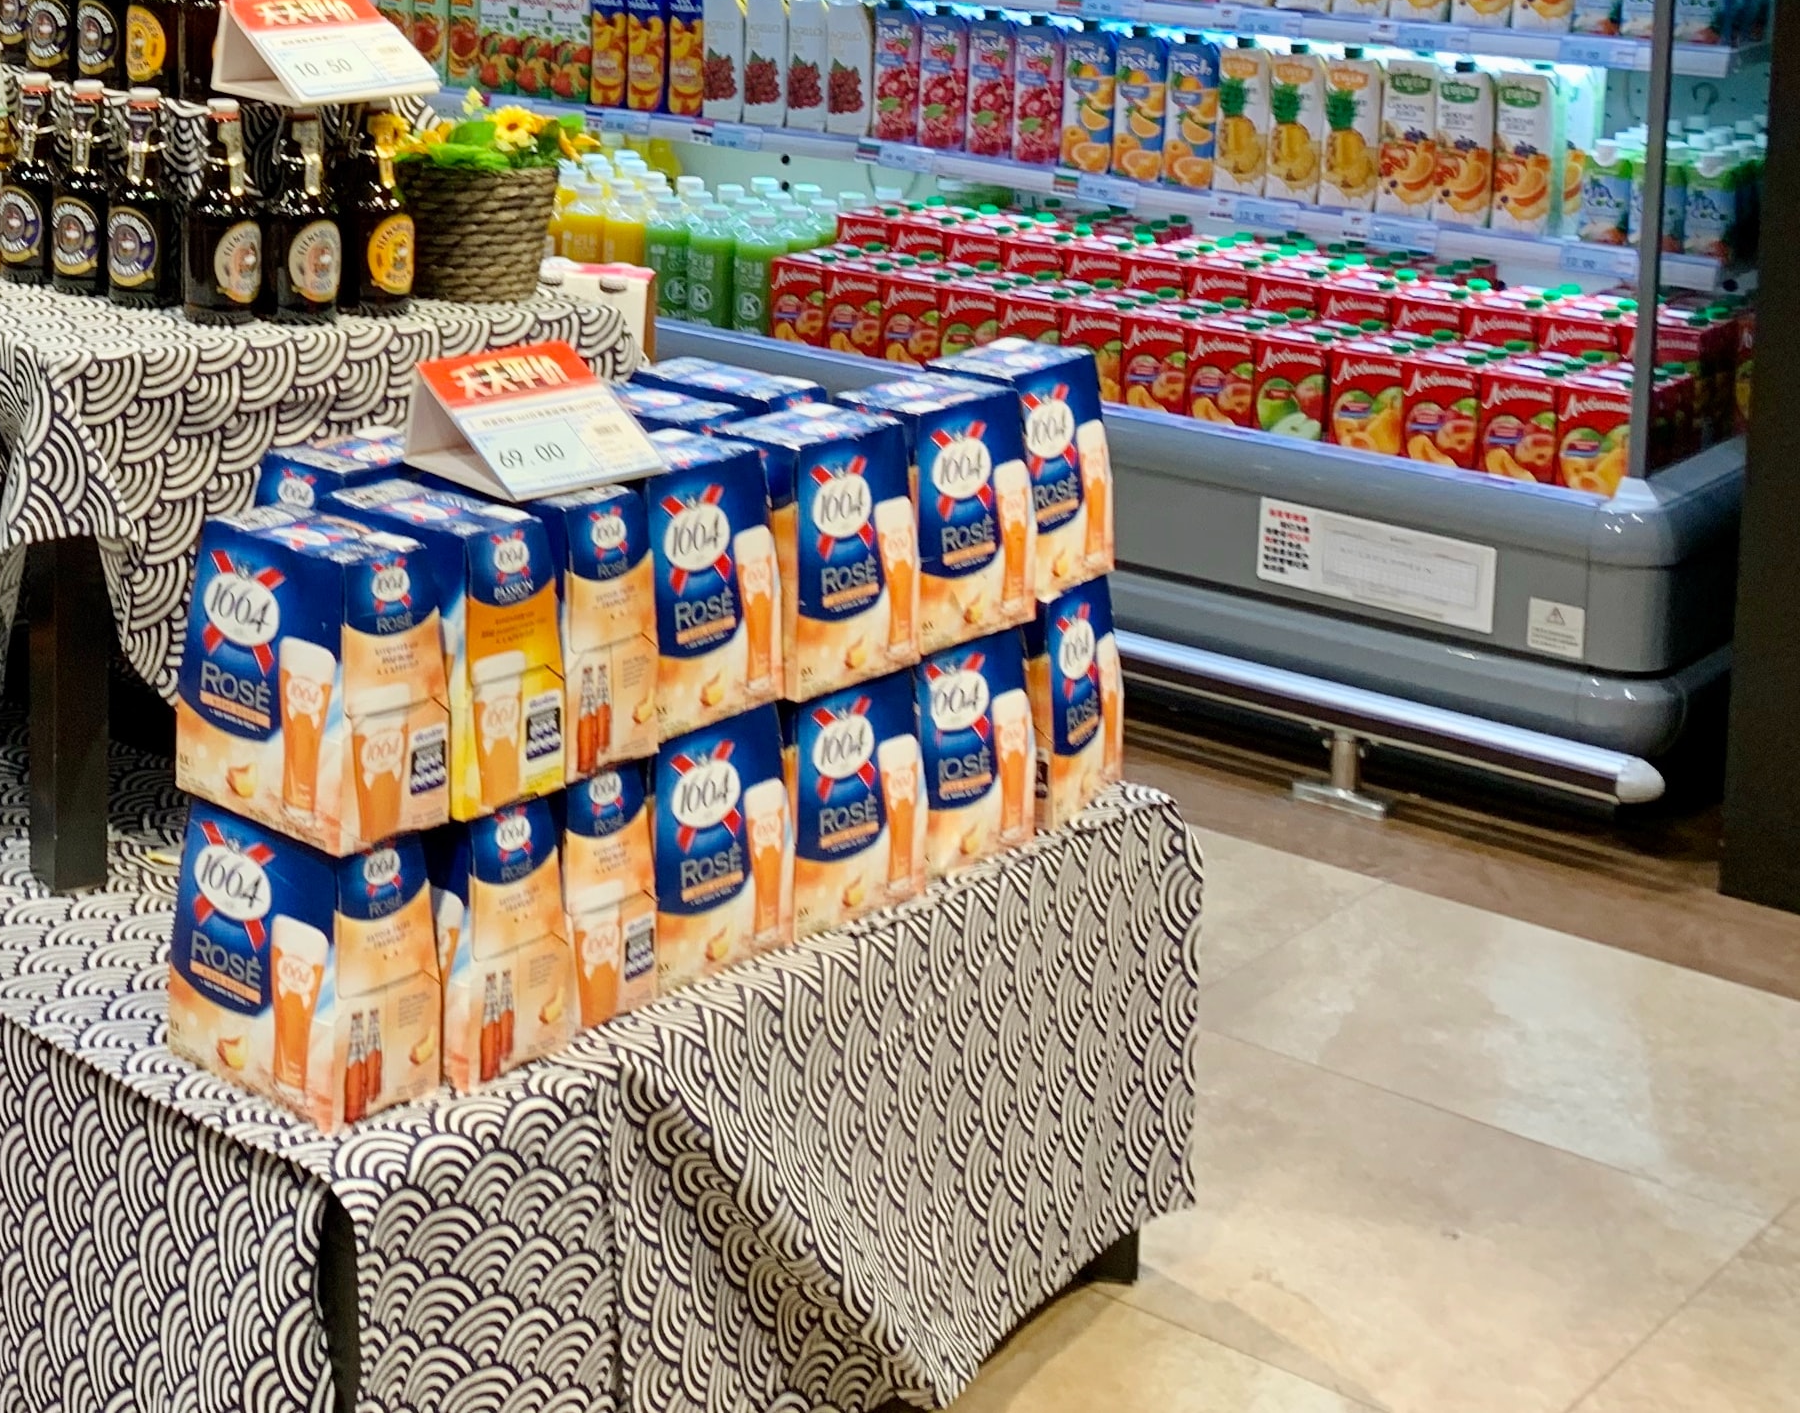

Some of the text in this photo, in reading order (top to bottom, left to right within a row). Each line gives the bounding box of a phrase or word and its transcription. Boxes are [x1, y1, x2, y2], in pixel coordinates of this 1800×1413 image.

[295, 58, 353, 78] 10.50
[451, 354, 569, 399] 天天平价
[1031, 413, 1066, 446] 1664
[499, 442, 565, 469] 69.00
[940, 454, 983, 484] 1664
[820, 489, 863, 523] 1664
[671, 515, 720, 556] 1664
[941, 511, 995, 552] ROSÉ
[821, 554, 878, 594] ROSÉ
[210, 583, 271, 633] 1664
[675, 587, 734, 631] ROSÉ
[201, 660, 271, 714] ROSÉ
[933, 687, 980, 716] 664
[821, 727, 864, 766] 1664
[680, 773, 730, 815] 1664
[820, 794, 878, 836] ROSÉ
[201, 854, 263, 908] 1664
[680, 842, 743, 887] ROSÉ
[192, 930, 262, 988] ROSÉ
